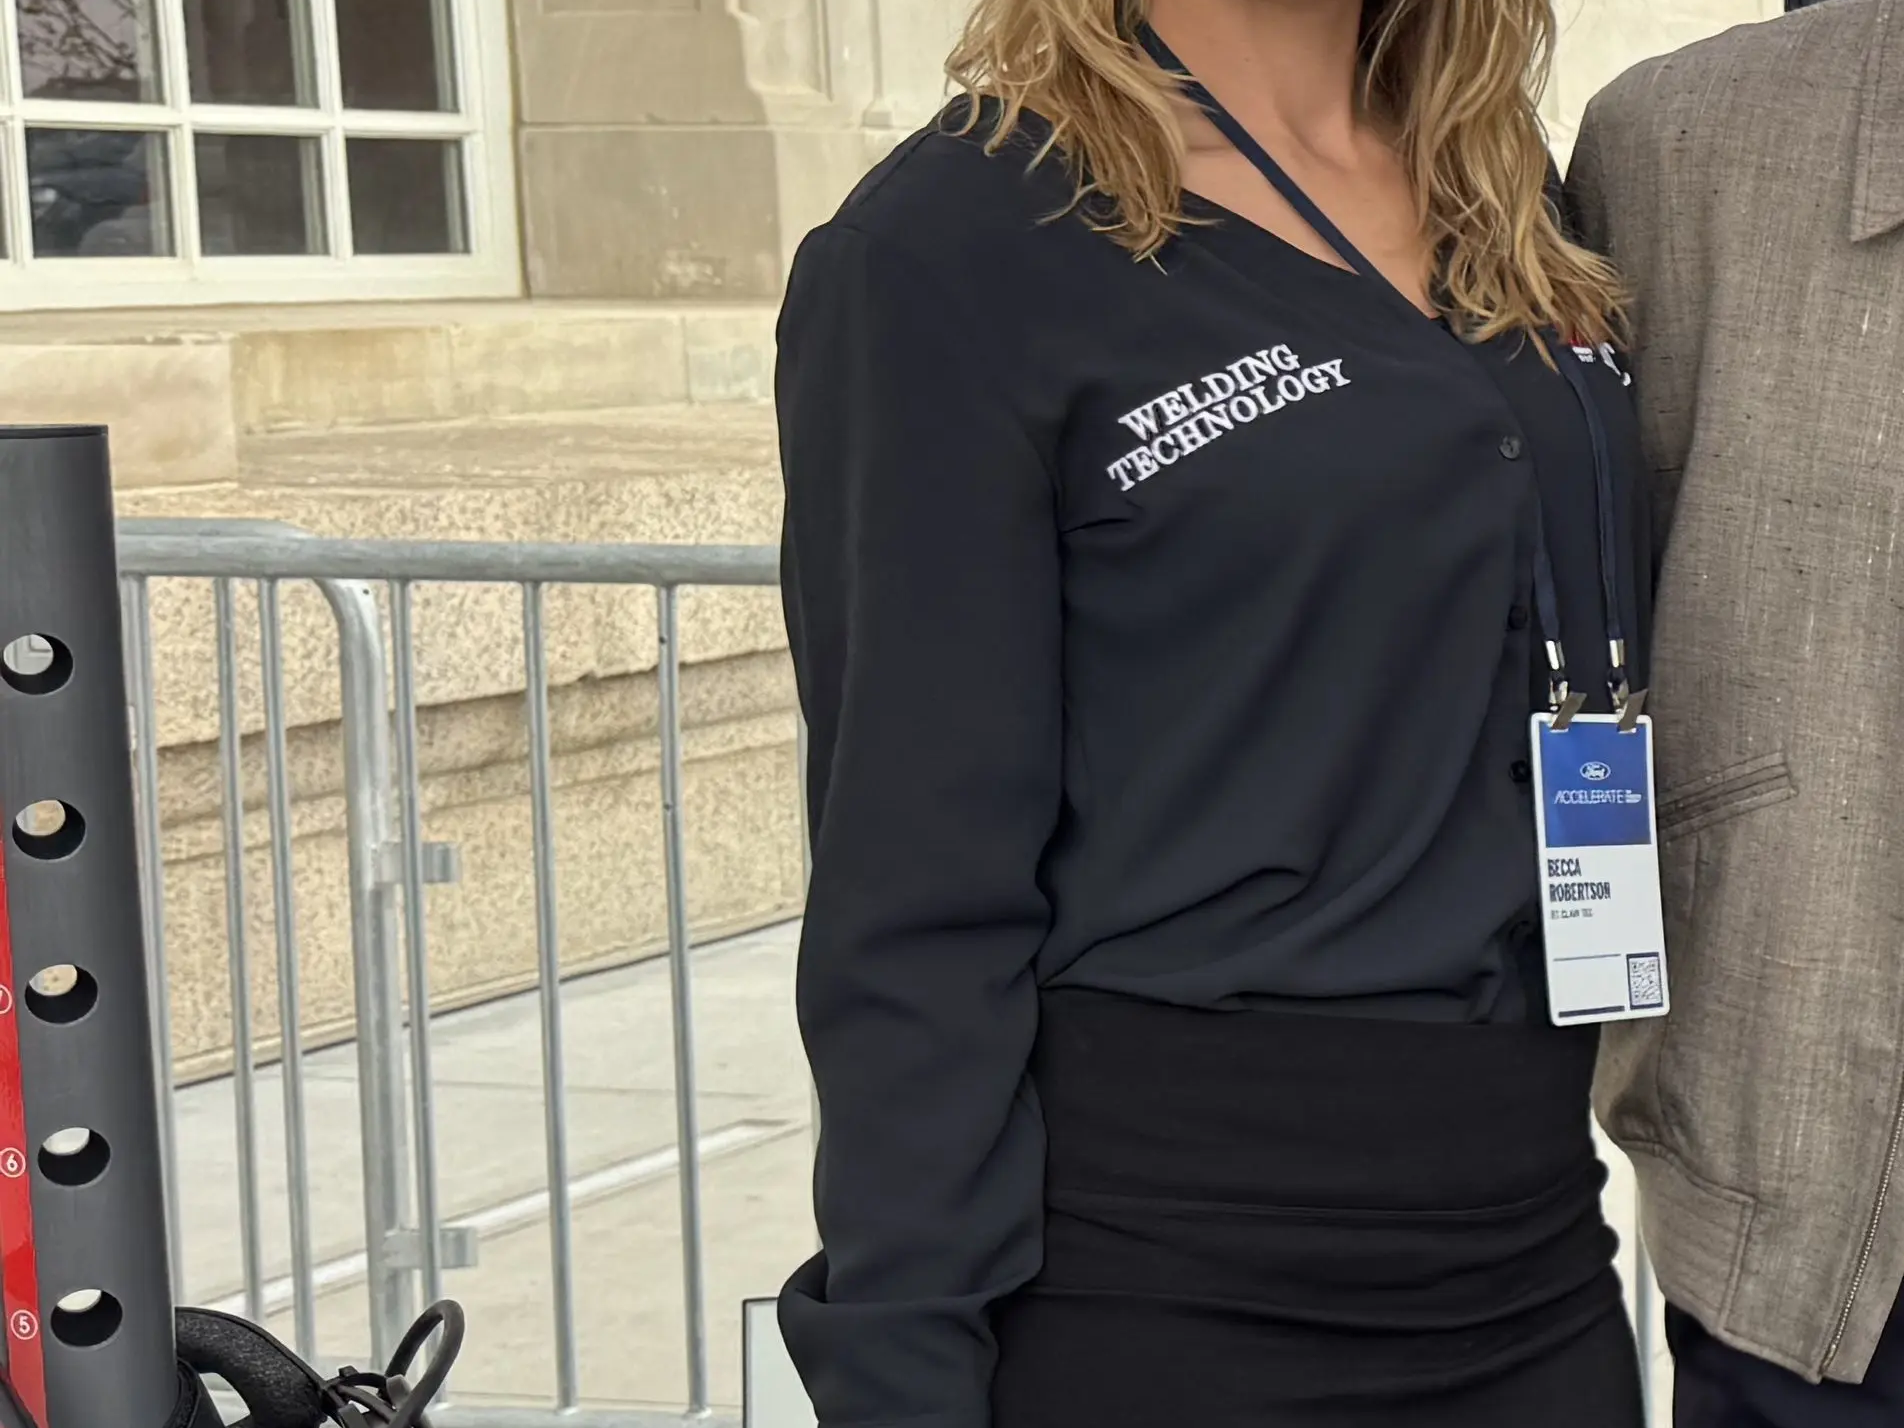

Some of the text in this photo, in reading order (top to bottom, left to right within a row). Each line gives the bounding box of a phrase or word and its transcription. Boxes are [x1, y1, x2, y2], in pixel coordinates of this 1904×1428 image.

[1117, 342, 1300, 442] WELDING
[1107, 358, 1352, 491] TECHNOLOGY
[1547, 858, 1582, 878] BECCA
[1549, 882, 1612, 903] ROBERTSON
[6, 1154, 18, 1172] 6
[19, 1313, 30, 1336] 5
